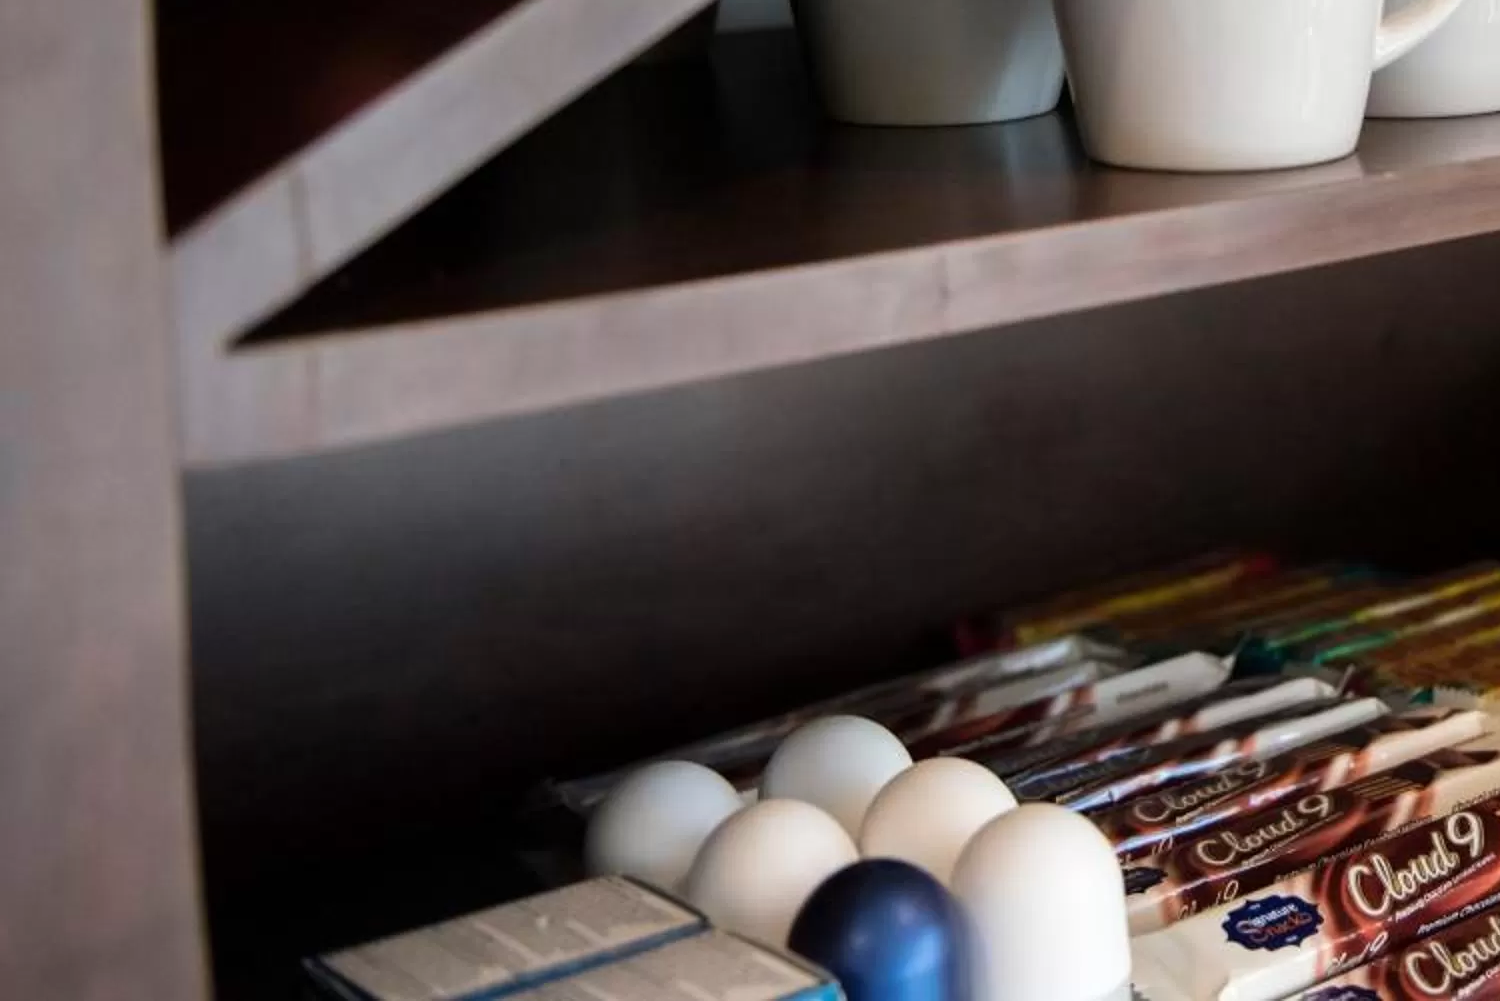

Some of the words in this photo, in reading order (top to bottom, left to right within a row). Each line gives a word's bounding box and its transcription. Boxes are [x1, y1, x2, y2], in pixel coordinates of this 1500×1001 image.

[1196, 812, 1300, 866] Cloud
[1299, 793, 1332, 823] 9
[1346, 830, 1461, 918] Cloud
[1445, 809, 1487, 860] 9
